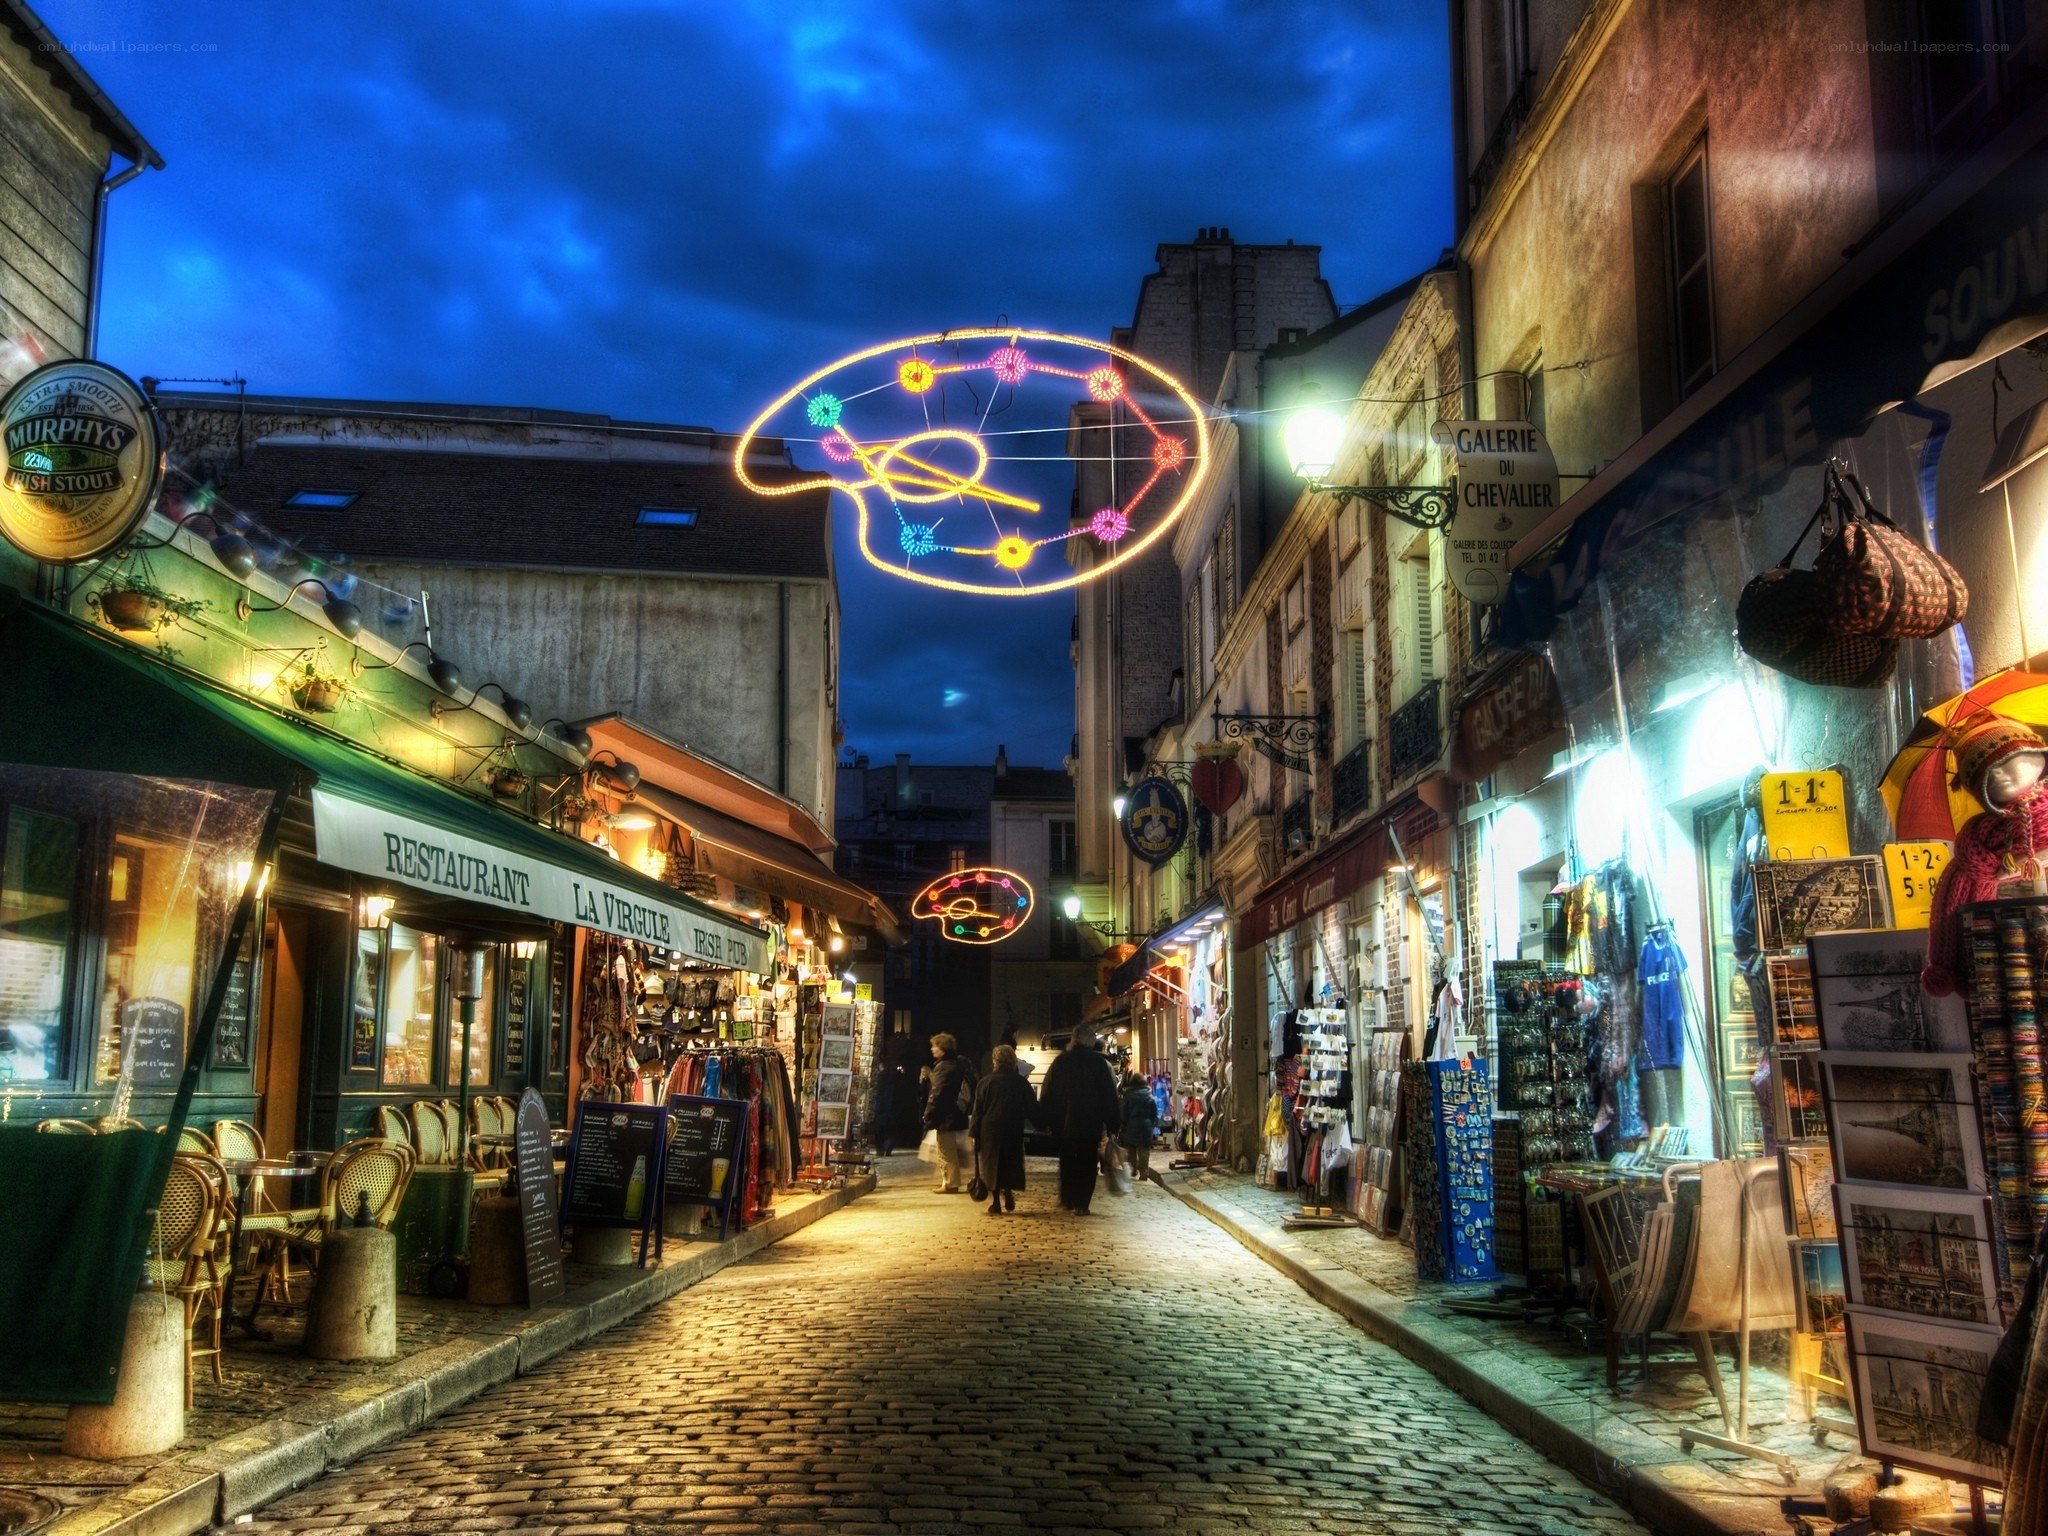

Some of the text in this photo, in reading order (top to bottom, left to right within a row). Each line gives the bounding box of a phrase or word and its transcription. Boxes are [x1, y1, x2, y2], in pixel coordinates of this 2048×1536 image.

[19, 381, 124, 414] EXTRA SMOOTH
[9, 417, 125, 451] MURPHY'S
[1457, 428, 1537, 454] GALERIE
[1500, 460, 1515, 476] DU
[11, 471, 115, 492] IRISH STOUT
[1464, 482, 1553, 508] CHEVALIER
[1477, 540, 1488, 549] DES
[1479, 552, 1487, 563] 01
[1489, 552, 1499, 563] 42
[384, 831, 748, 966] RESTAURANT LA VIRGULE IRISH PUB
[1903, 876, 1914, 898] 5
